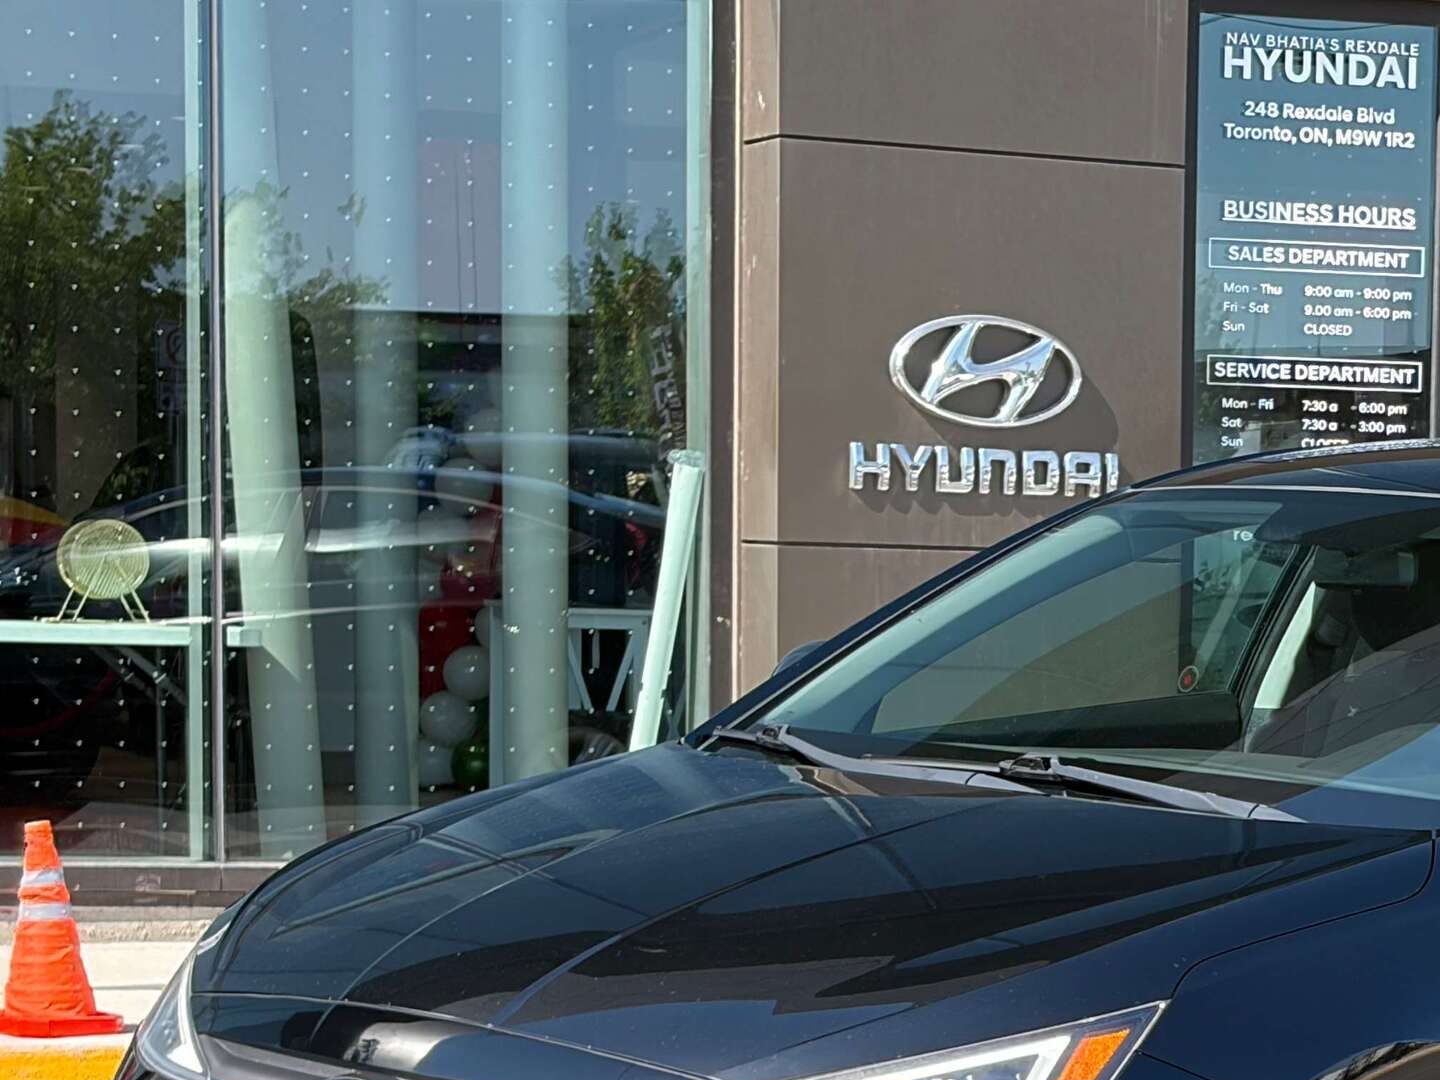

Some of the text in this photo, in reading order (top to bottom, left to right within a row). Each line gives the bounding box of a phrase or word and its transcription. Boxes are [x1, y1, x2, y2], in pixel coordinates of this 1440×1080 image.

[1226, 32, 1419, 56] NAV BHATIA'S REXDALE
[1224, 45, 1417, 89] HYUNDAI
[1244, 101, 1395, 124] 248 Rexdale Blvd
[1224, 123, 1415, 148] Toronto, ON, M9W 1R2
[1224, 200, 1416, 227] BUSINESS HOURS
[1228, 246, 1410, 268] SALES DEPARTMENT
[1223, 283, 1249, 293] Mon
[1260, 284, 1282, 295] Thu
[1304, 285, 1332, 297] 9:00
[1334, 288, 1353, 298] am
[1363, 288, 1390, 299] 9:00
[1392, 291, 1412, 302] pm
[1223, 302, 1238, 312] Fri
[1248, 303, 1270, 314] Sat
[1333, 308, 1353, 317] am
[1363, 307, 1390, 319] 6:00
[1392, 310, 1411, 321] pm
[1222, 321, 1245, 332] Sun
[1304, 324, 1352, 336] CLOSED
[1214, 362, 1416, 384] SERVICE DEPARTMENT
[1222, 398, 1248, 409] Mon
[1258, 399, 1275, 410] Fri
[1358, 402, 1385, 414] 6:00
[1387, 404, 1407, 416] pm
[1221, 416, 1242, 427] Sat
[1358, 421, 1384, 433] 3:00
[1386, 424, 1406, 436] pm
[1220, 436, 1244, 447] Sun
[849, 441, 1120, 499] HYUNDAI
